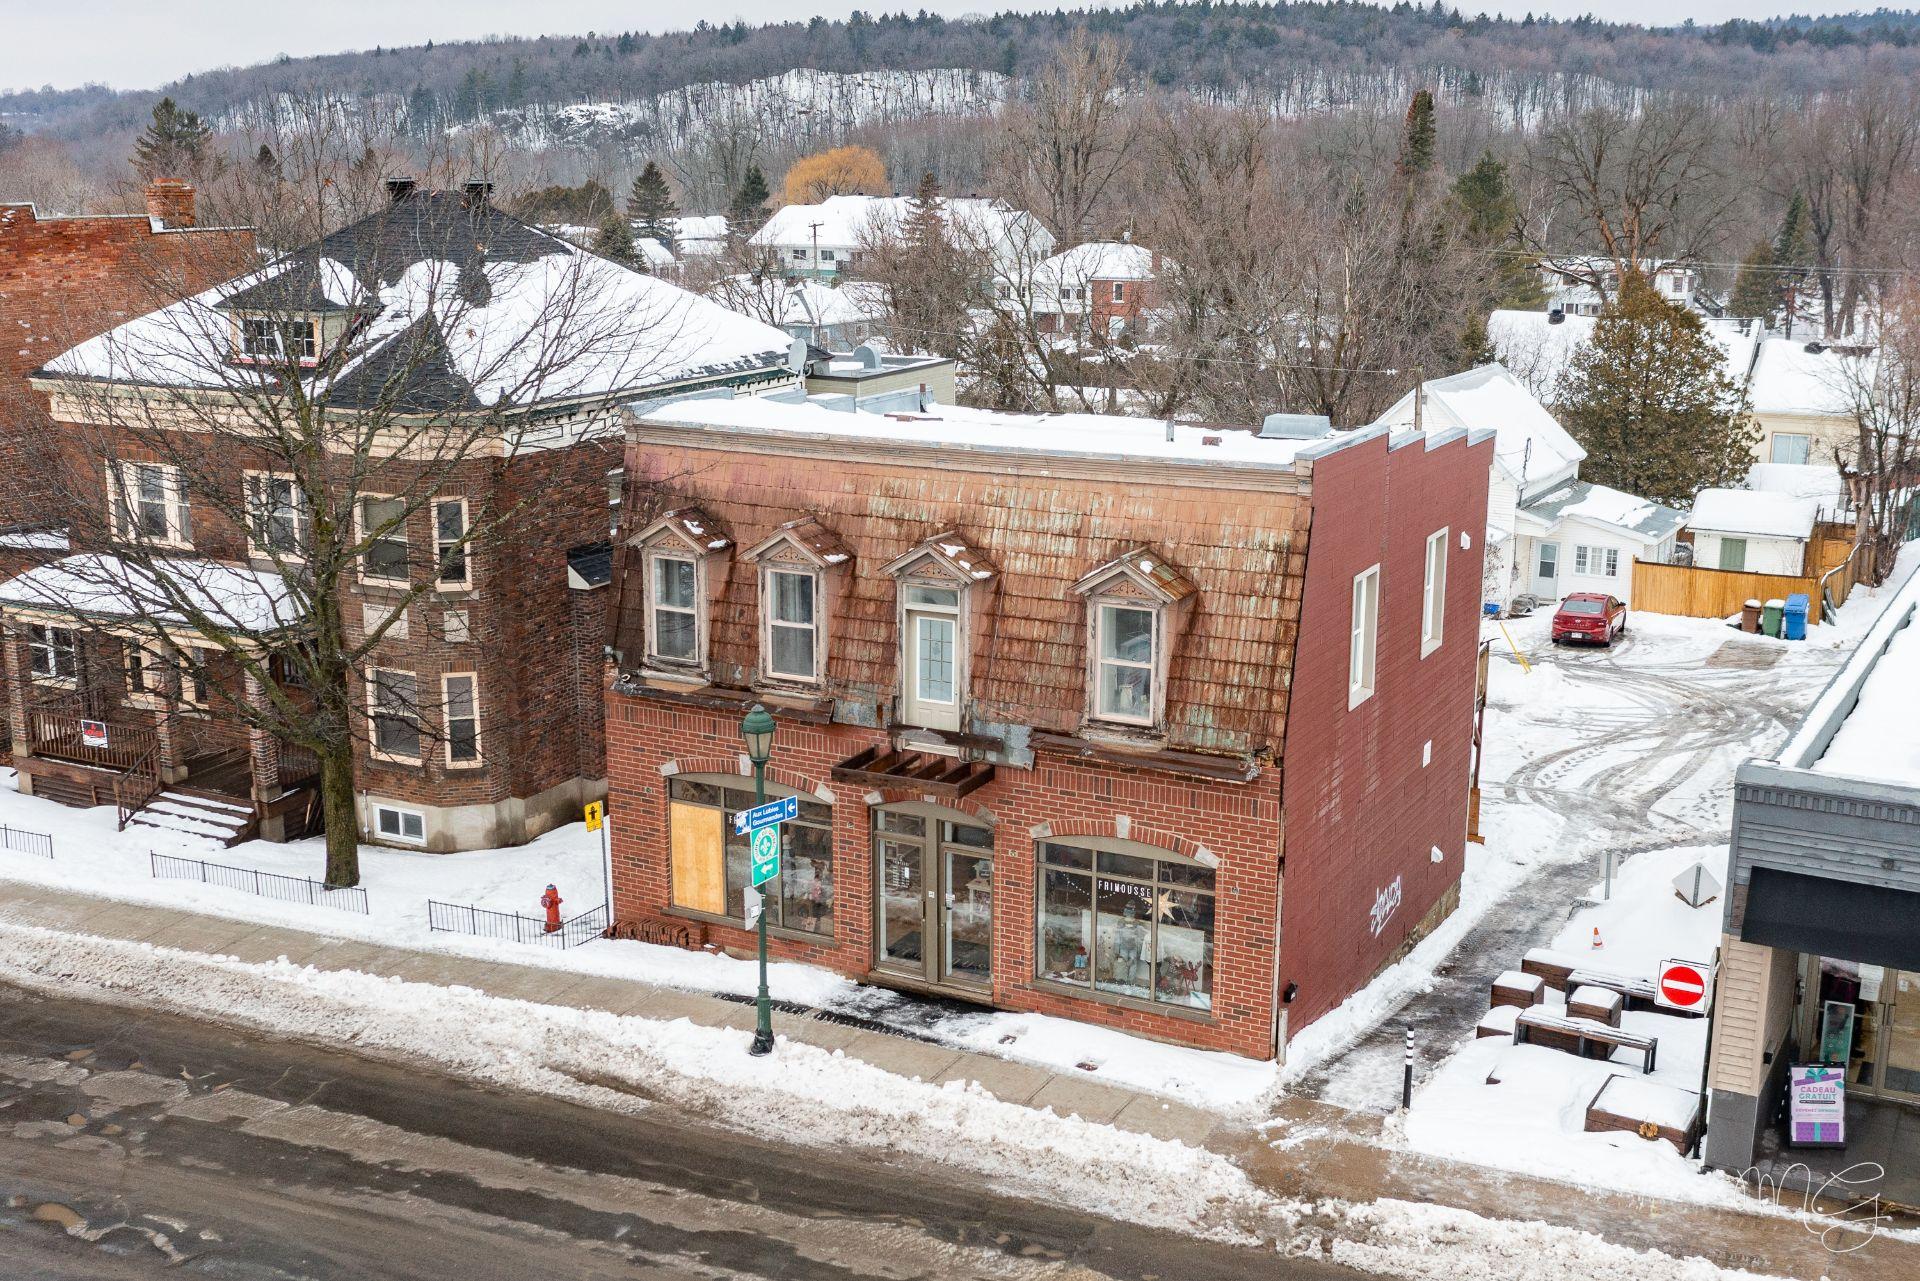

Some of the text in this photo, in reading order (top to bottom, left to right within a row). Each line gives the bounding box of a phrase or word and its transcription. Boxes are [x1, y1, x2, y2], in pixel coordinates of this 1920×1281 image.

[752, 805, 780, 819] Aux Lubies
[752, 812, 784, 826] Gourmandes
[1098, 880, 1152, 898] FRIMOUSSE
